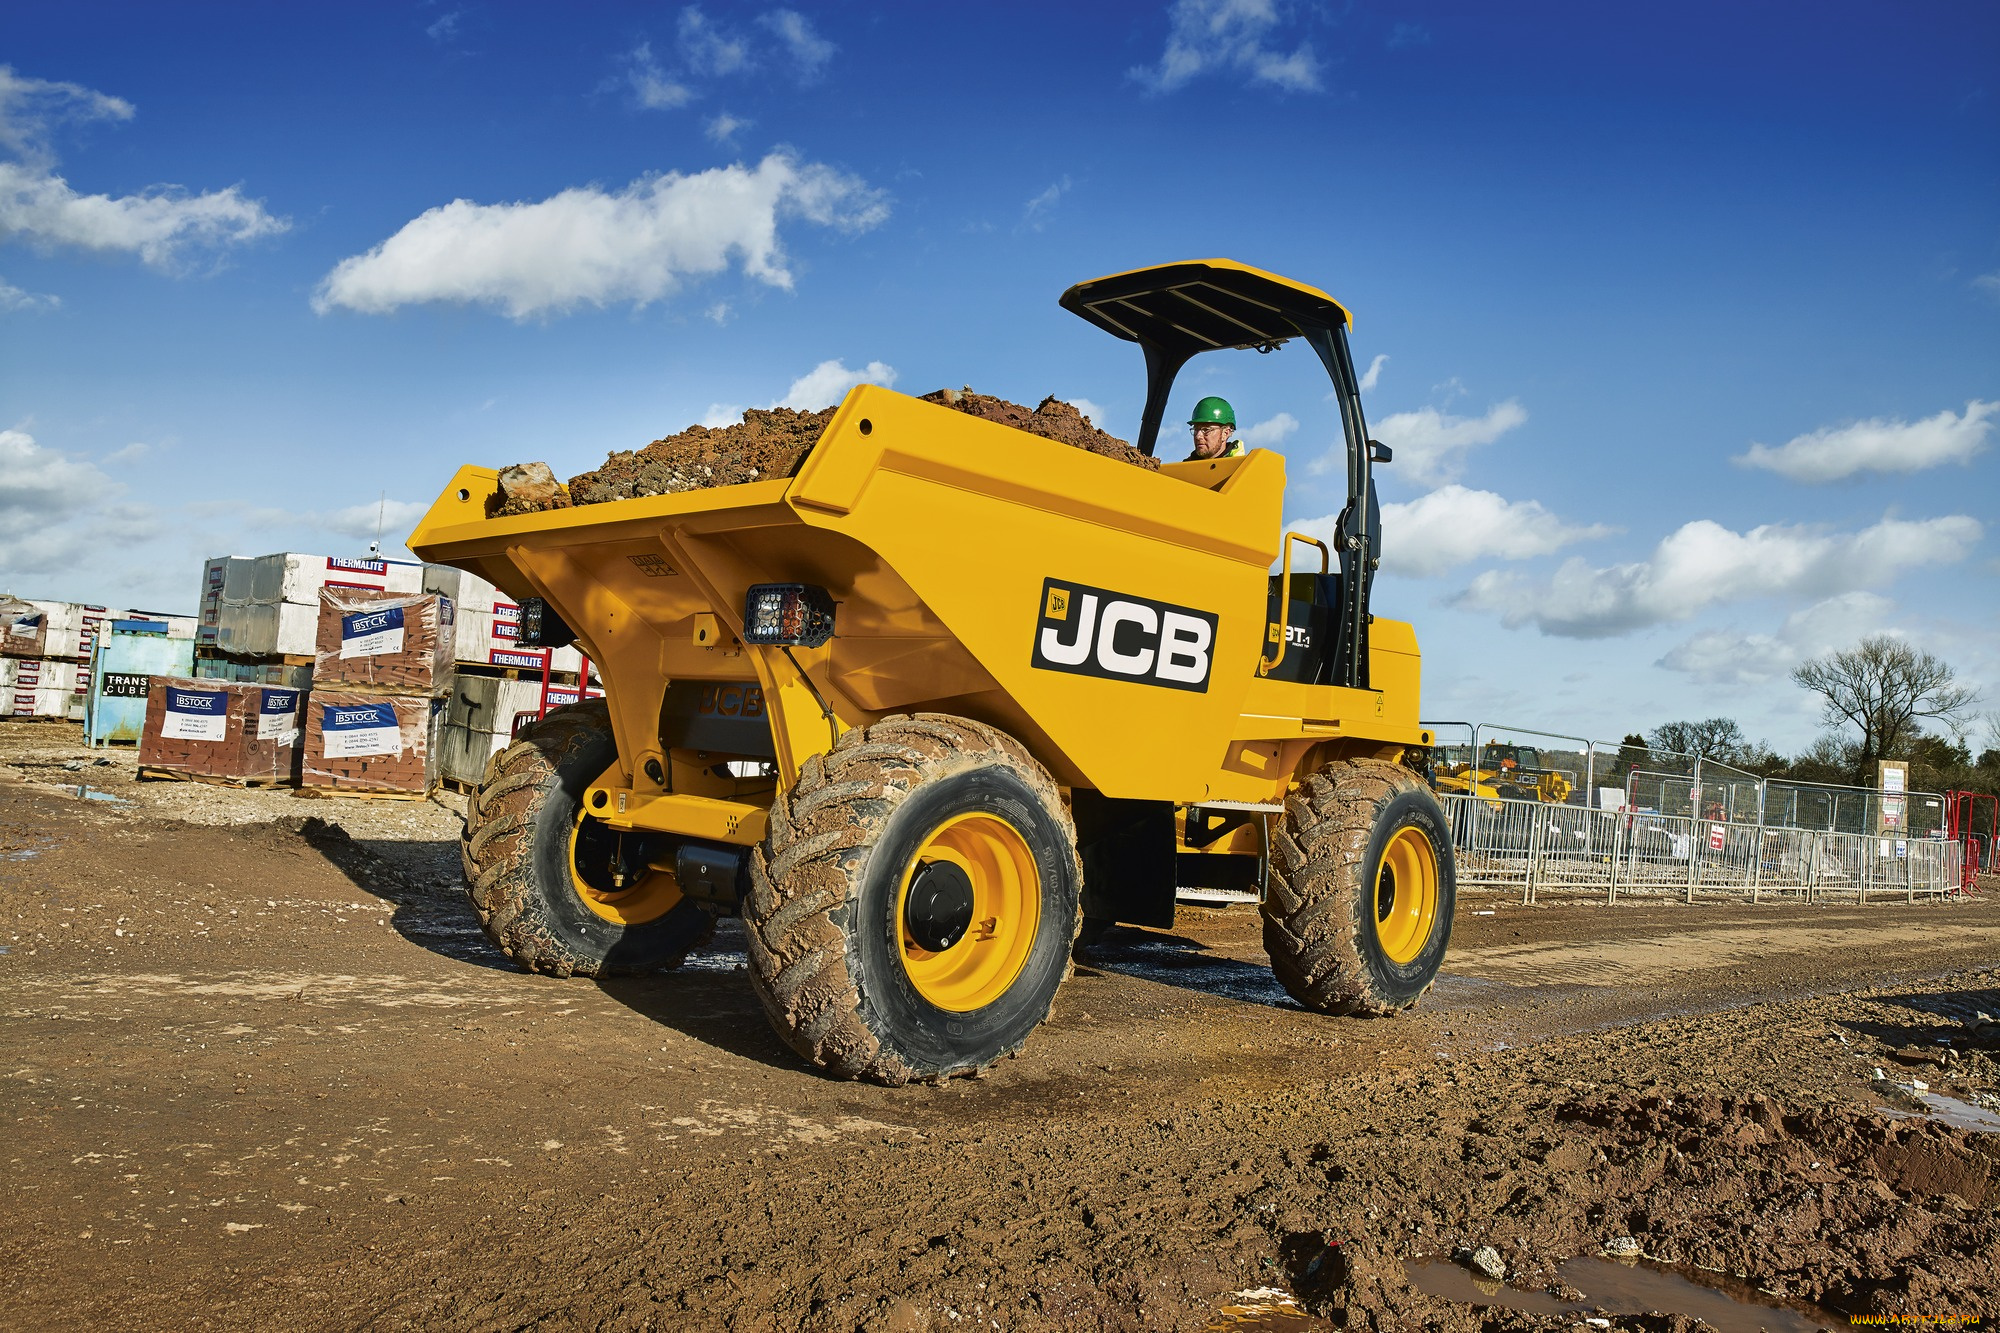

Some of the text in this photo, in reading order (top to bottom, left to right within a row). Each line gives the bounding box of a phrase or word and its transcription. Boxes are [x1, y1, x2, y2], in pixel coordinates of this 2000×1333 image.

[332, 557, 383, 572] THERMALITE
[1052, 595, 1066, 611] JCB
[1041, 594, 1212, 684] JCB
[493, 653, 542, 667] THERMALITE
[108, 675, 147, 686] TRANS
[106, 685, 146, 695] CUBE
[176, 696, 213, 708] IBSTOCK
[699, 684, 764, 717] JCB
[335, 712, 379, 723] IBSTOCK
[1515, 774, 1538, 785] JCB
